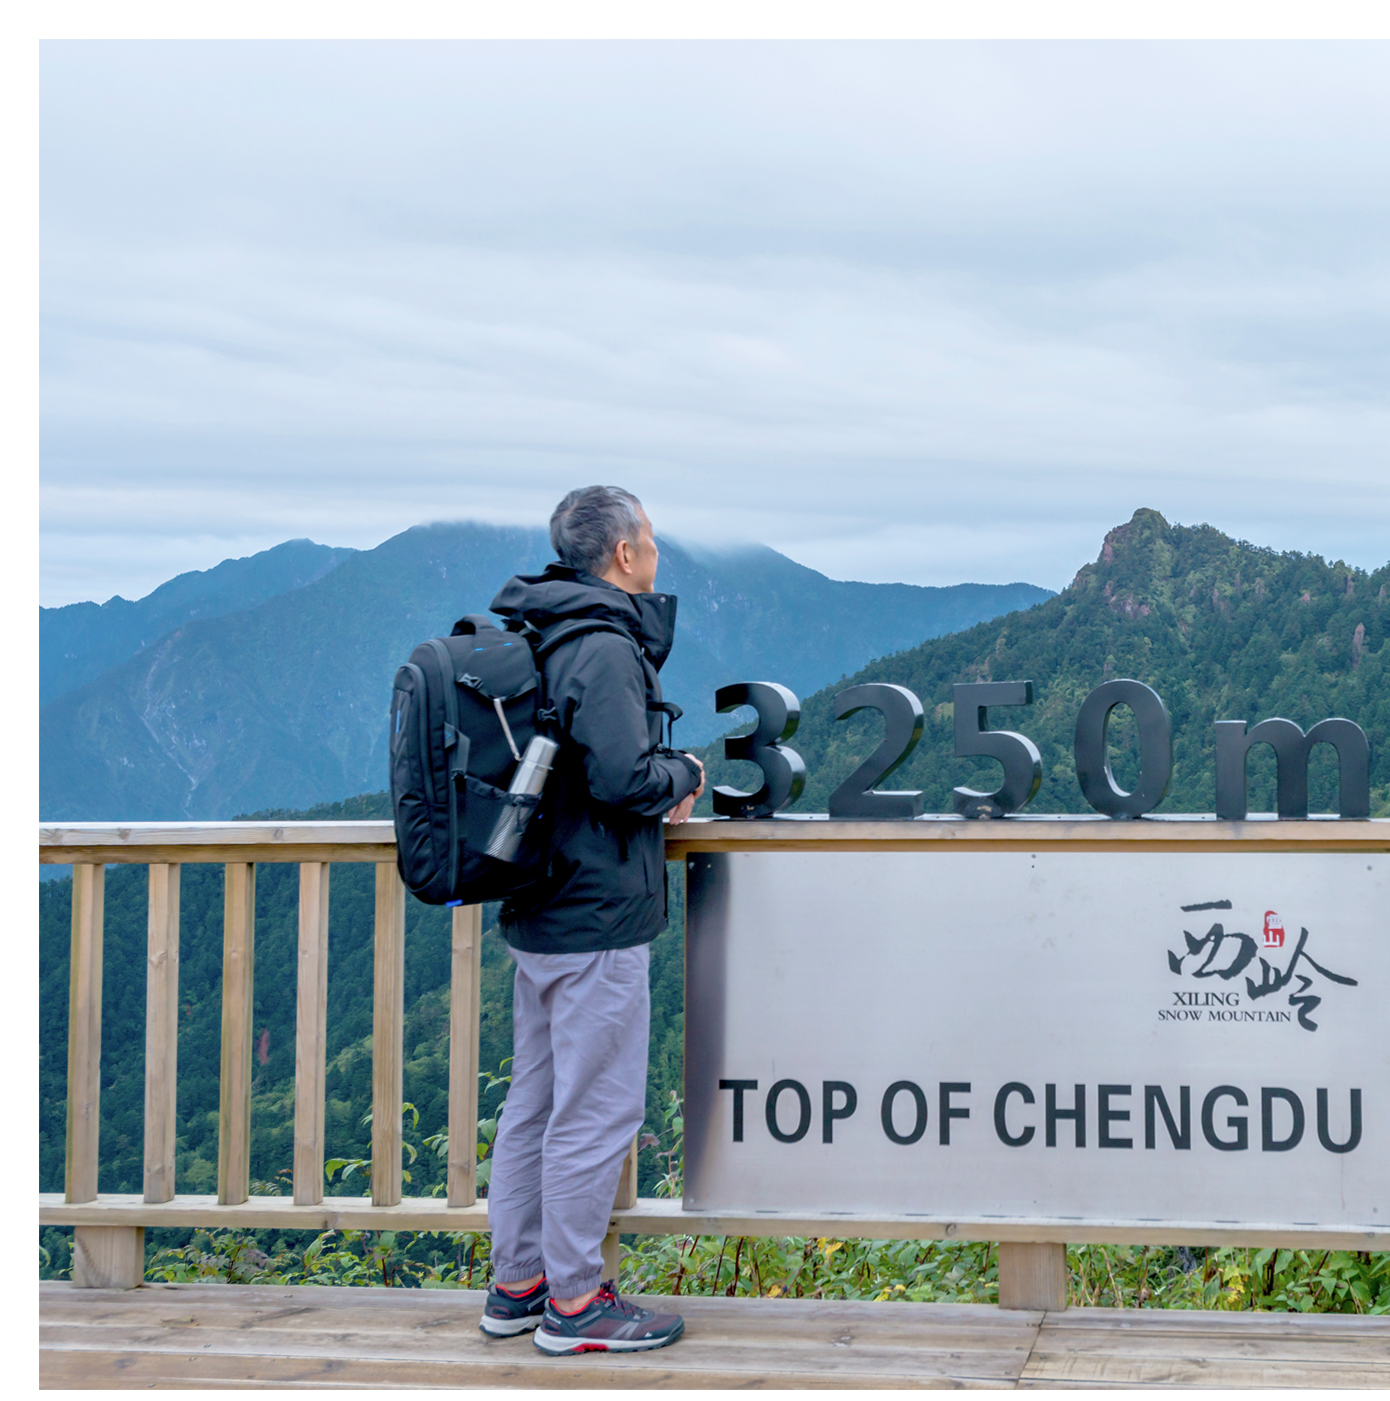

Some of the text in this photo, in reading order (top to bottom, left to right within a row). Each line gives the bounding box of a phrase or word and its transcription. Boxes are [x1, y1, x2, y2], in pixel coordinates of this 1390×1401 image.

[1167, 899, 1358, 1032] 西岭
[1158, 1009, 1291, 1022] SNOW MOUNTAIN
[1172, 992, 1240, 1007] XILING
[718, 1079, 1363, 1154] TOP OF CHENGDU
